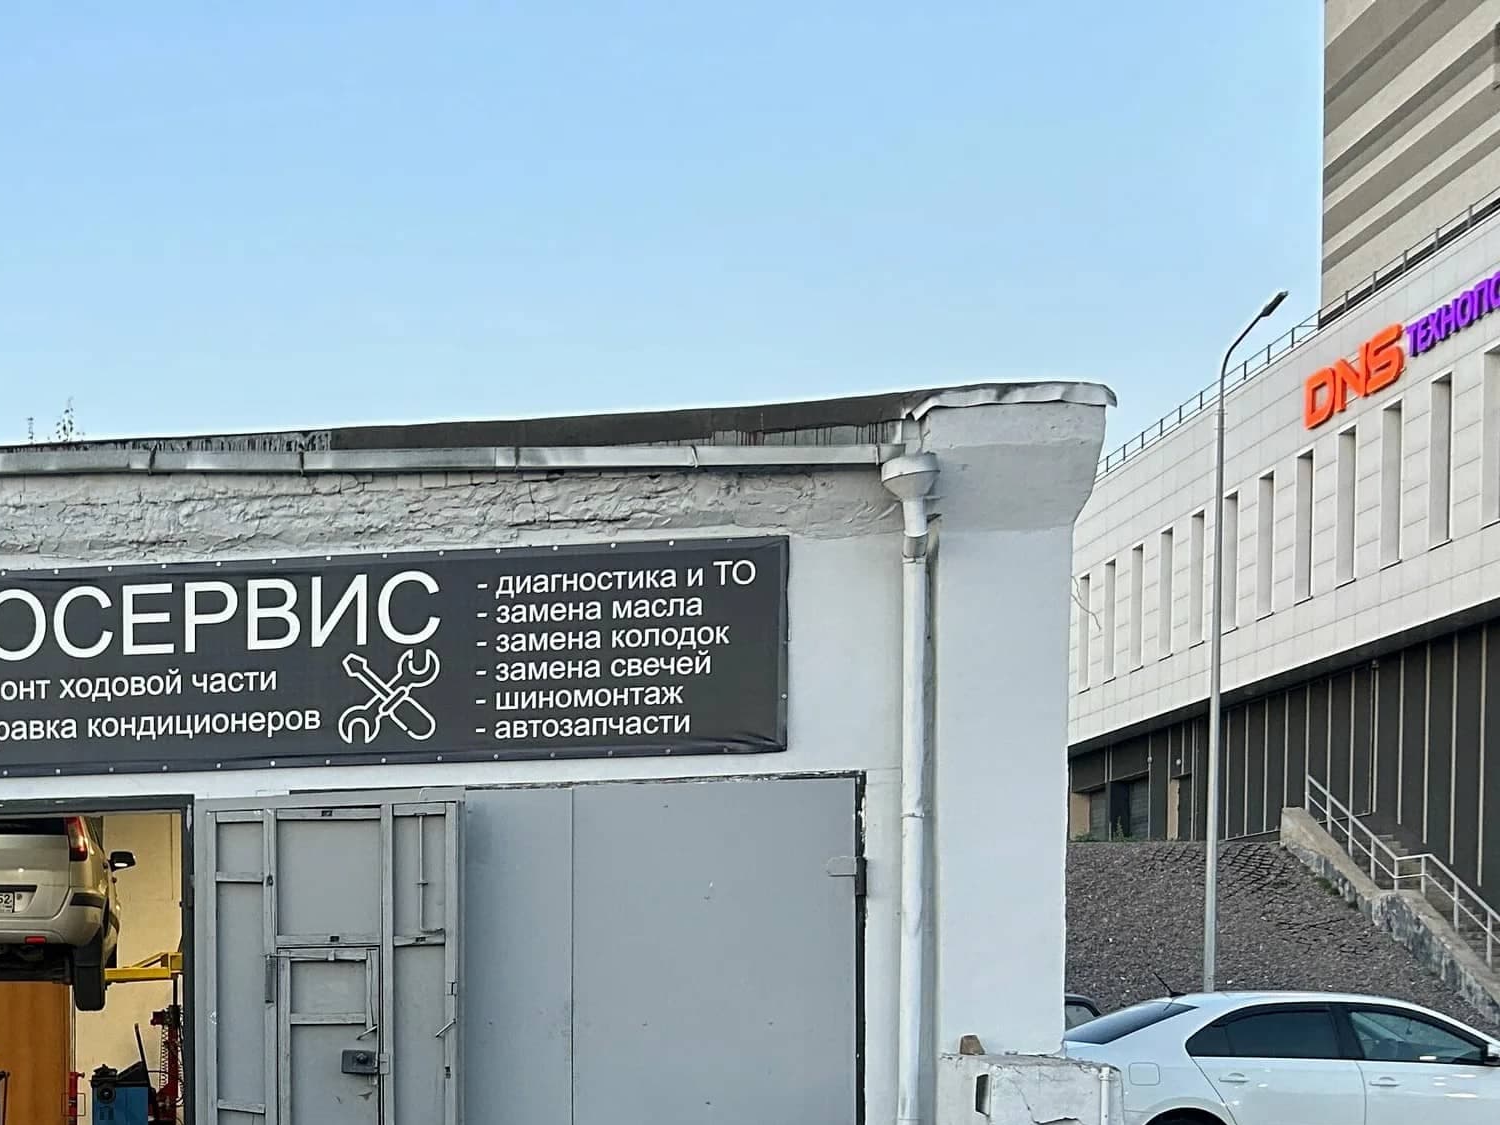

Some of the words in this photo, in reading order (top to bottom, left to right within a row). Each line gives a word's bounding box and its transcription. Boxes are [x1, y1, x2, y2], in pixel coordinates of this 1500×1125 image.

[1304, 323, 1405, 430] DNS
[495, 569, 677, 600] диагностика
[687, 567, 704, 587] и
[712, 559, 756, 586] ТО
[495, 601, 602, 624] замена
[612, 597, 703, 619] масла
[495, 630, 601, 653] замена
[611, 625, 730, 651] колодок
[495, 659, 601, 682] замена
[610, 649, 711, 678] свечей
[59, 668, 182, 703] ходовой
[191, 670, 277, 694] части
[495, 685, 684, 711] шиномонтаж
[87, 709, 321, 741] кондиционеров
[494, 714, 690, 740] автозапчасти
